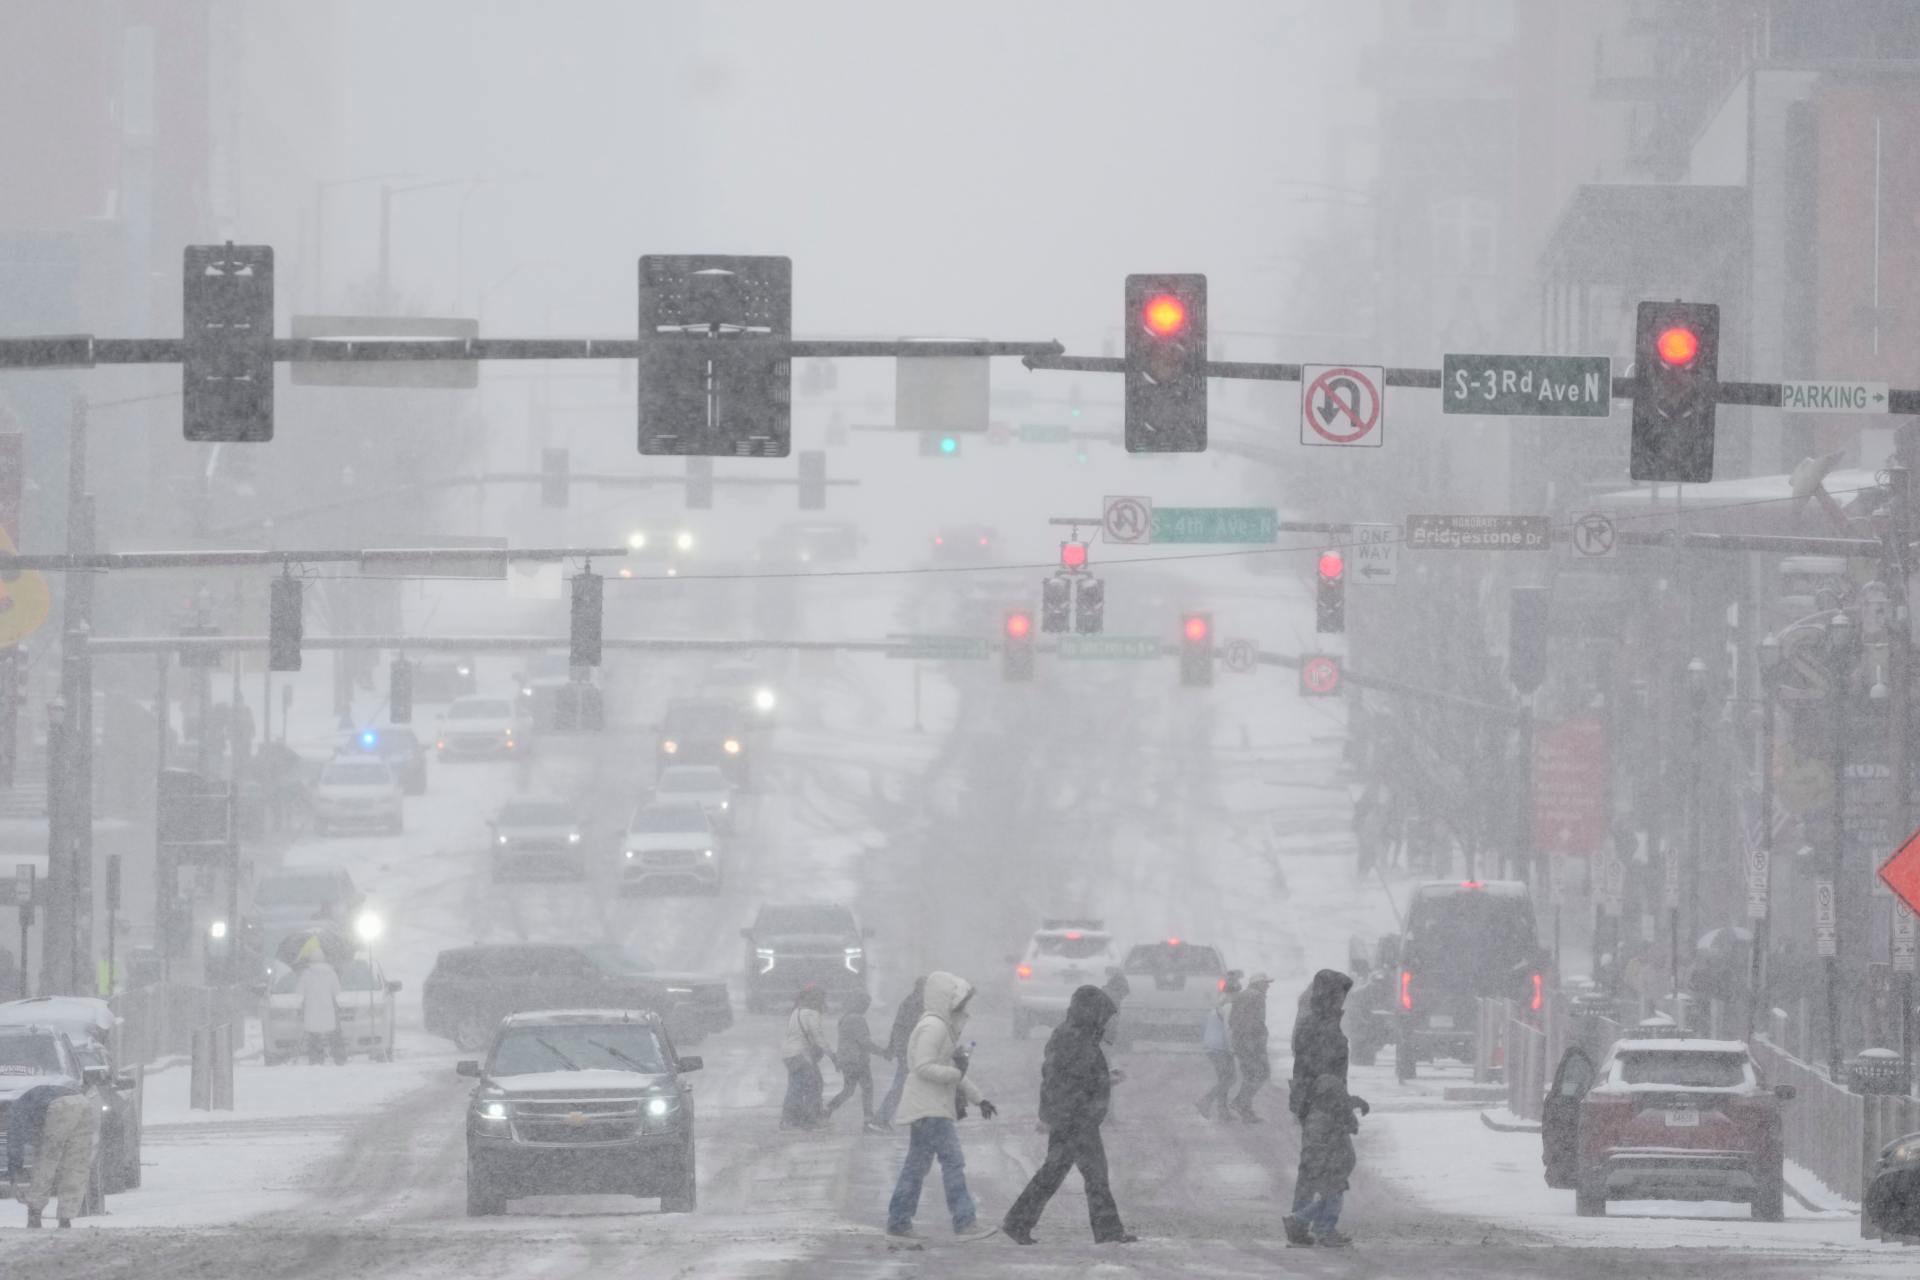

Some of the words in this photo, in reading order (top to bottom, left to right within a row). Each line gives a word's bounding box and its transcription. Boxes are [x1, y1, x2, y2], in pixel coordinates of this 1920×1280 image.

[1538, 378, 1580, 402] Ave
[1585, 373, 1600, 402] N
[1783, 385, 1867, 409] PARKING
[1360, 528, 1393, 544] ONE
[1413, 528, 1522, 547] Bridgestone
[1526, 532, 1544, 545] Dr
[1359, 545, 1392, 560] WAY
